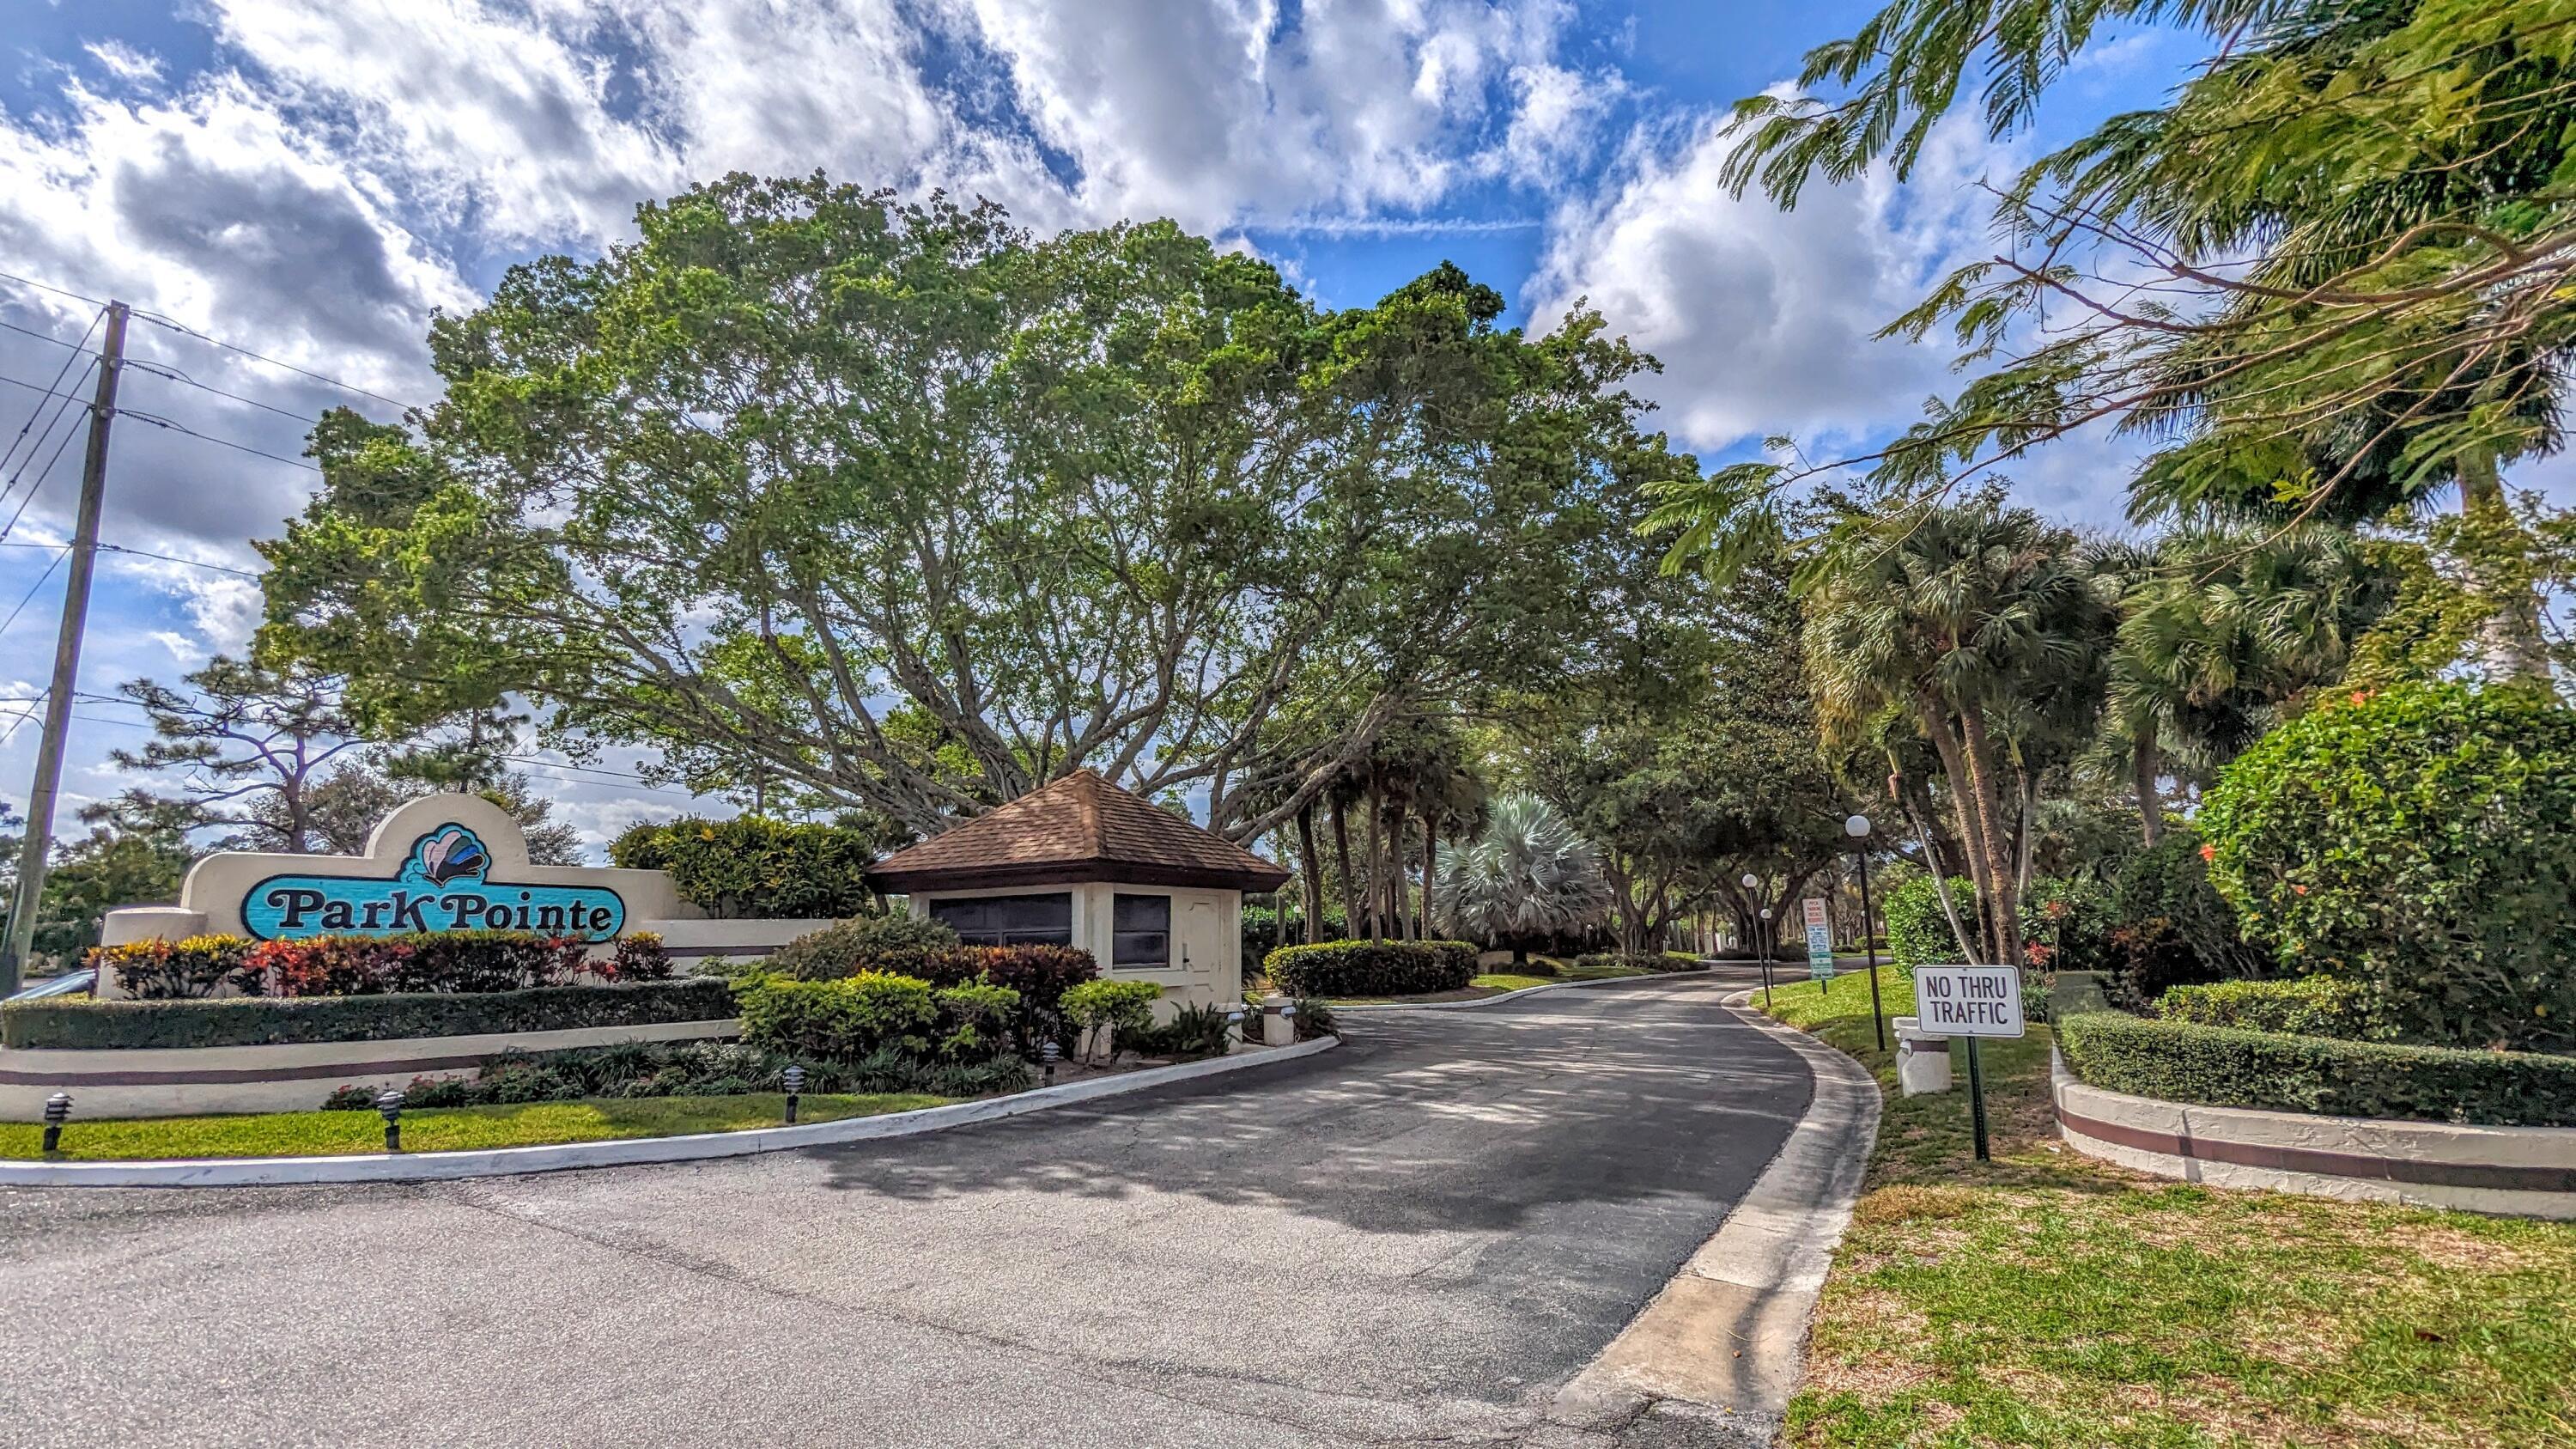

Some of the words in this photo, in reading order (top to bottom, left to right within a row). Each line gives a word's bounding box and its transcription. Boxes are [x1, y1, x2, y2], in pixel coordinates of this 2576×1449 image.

[440, 892, 612, 931] Pointe
[1925, 976, 1951, 998] NO
[1957, 976, 2008, 999] THRU
[1929, 1001, 2008, 1025] TRAFFIC
